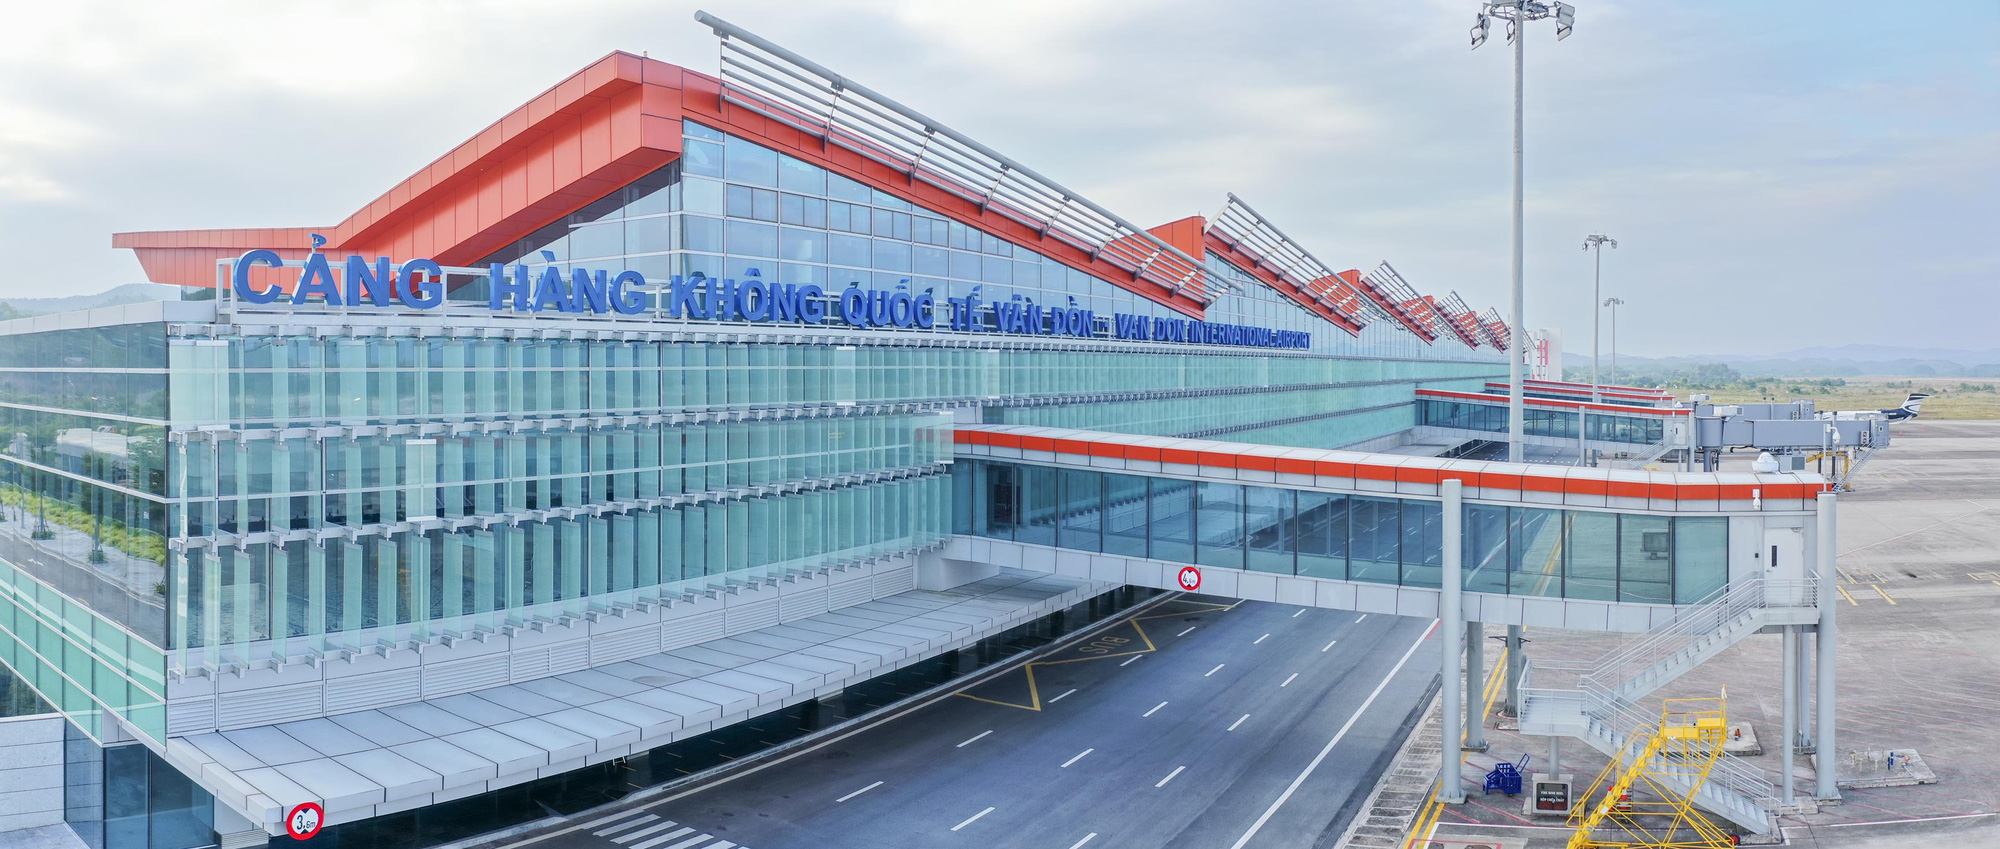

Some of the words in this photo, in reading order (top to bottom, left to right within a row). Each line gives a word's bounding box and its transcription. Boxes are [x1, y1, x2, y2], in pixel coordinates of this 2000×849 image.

[233, 233, 443, 310] CẢNG
[489, 250, 647, 315] HÀNG
[671, 268, 825, 323] KHÔNG
[840, 279, 935, 330] QUỐC
[948, 286, 984, 332] TẾ
[1051, 296, 1094, 337] ĐỒN
[1114, 313, 1151, 340] VAN
[1153, 317, 1186, 343] DON
[1188, 320, 1275, 348] INTERNATIONAL
[1275, 329, 1312, 350] AIRPORT
[1079, 636, 1131, 654] BUS
